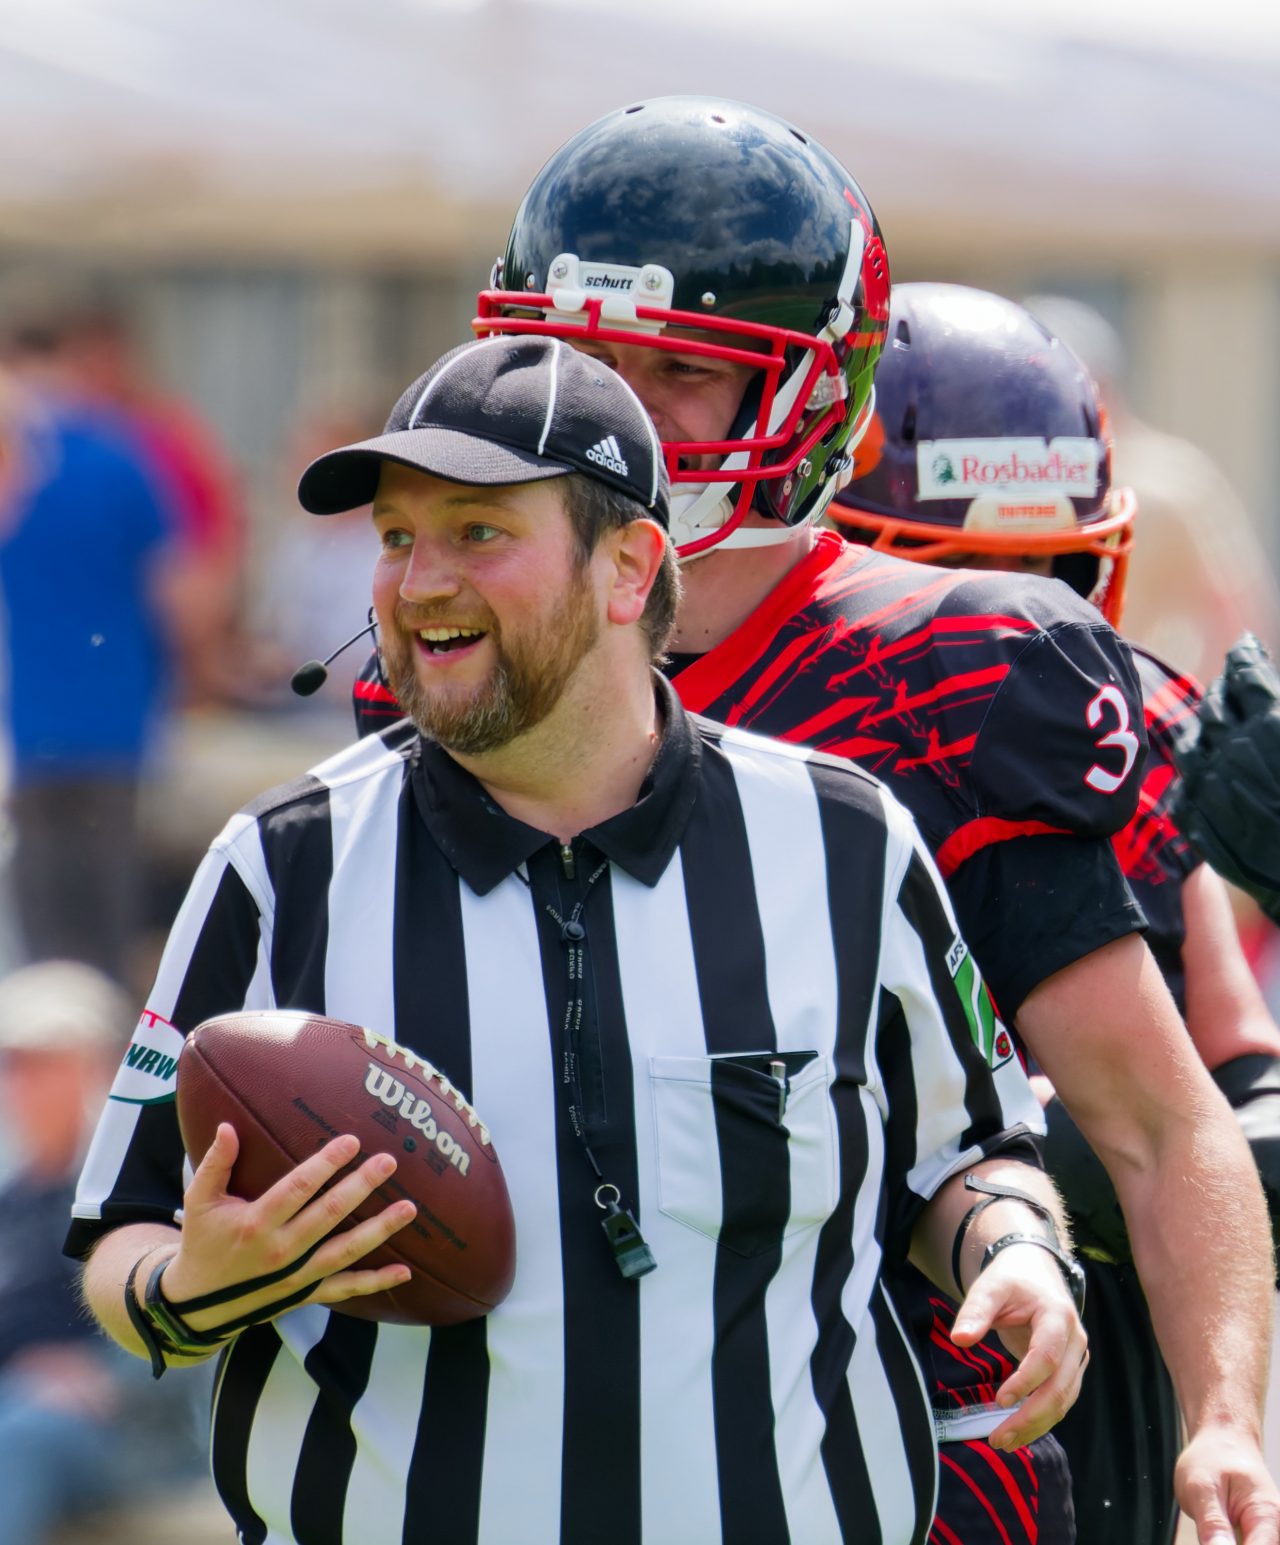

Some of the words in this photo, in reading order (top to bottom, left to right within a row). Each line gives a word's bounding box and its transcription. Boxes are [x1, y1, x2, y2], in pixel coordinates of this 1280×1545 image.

[584, 274, 634, 290] schutt
[585, 448, 629, 477] adidas
[961, 451, 1090, 486] Rosbacher
[1083, 683, 1139, 795] 3
[364, 1062, 471, 1178] Wilson
